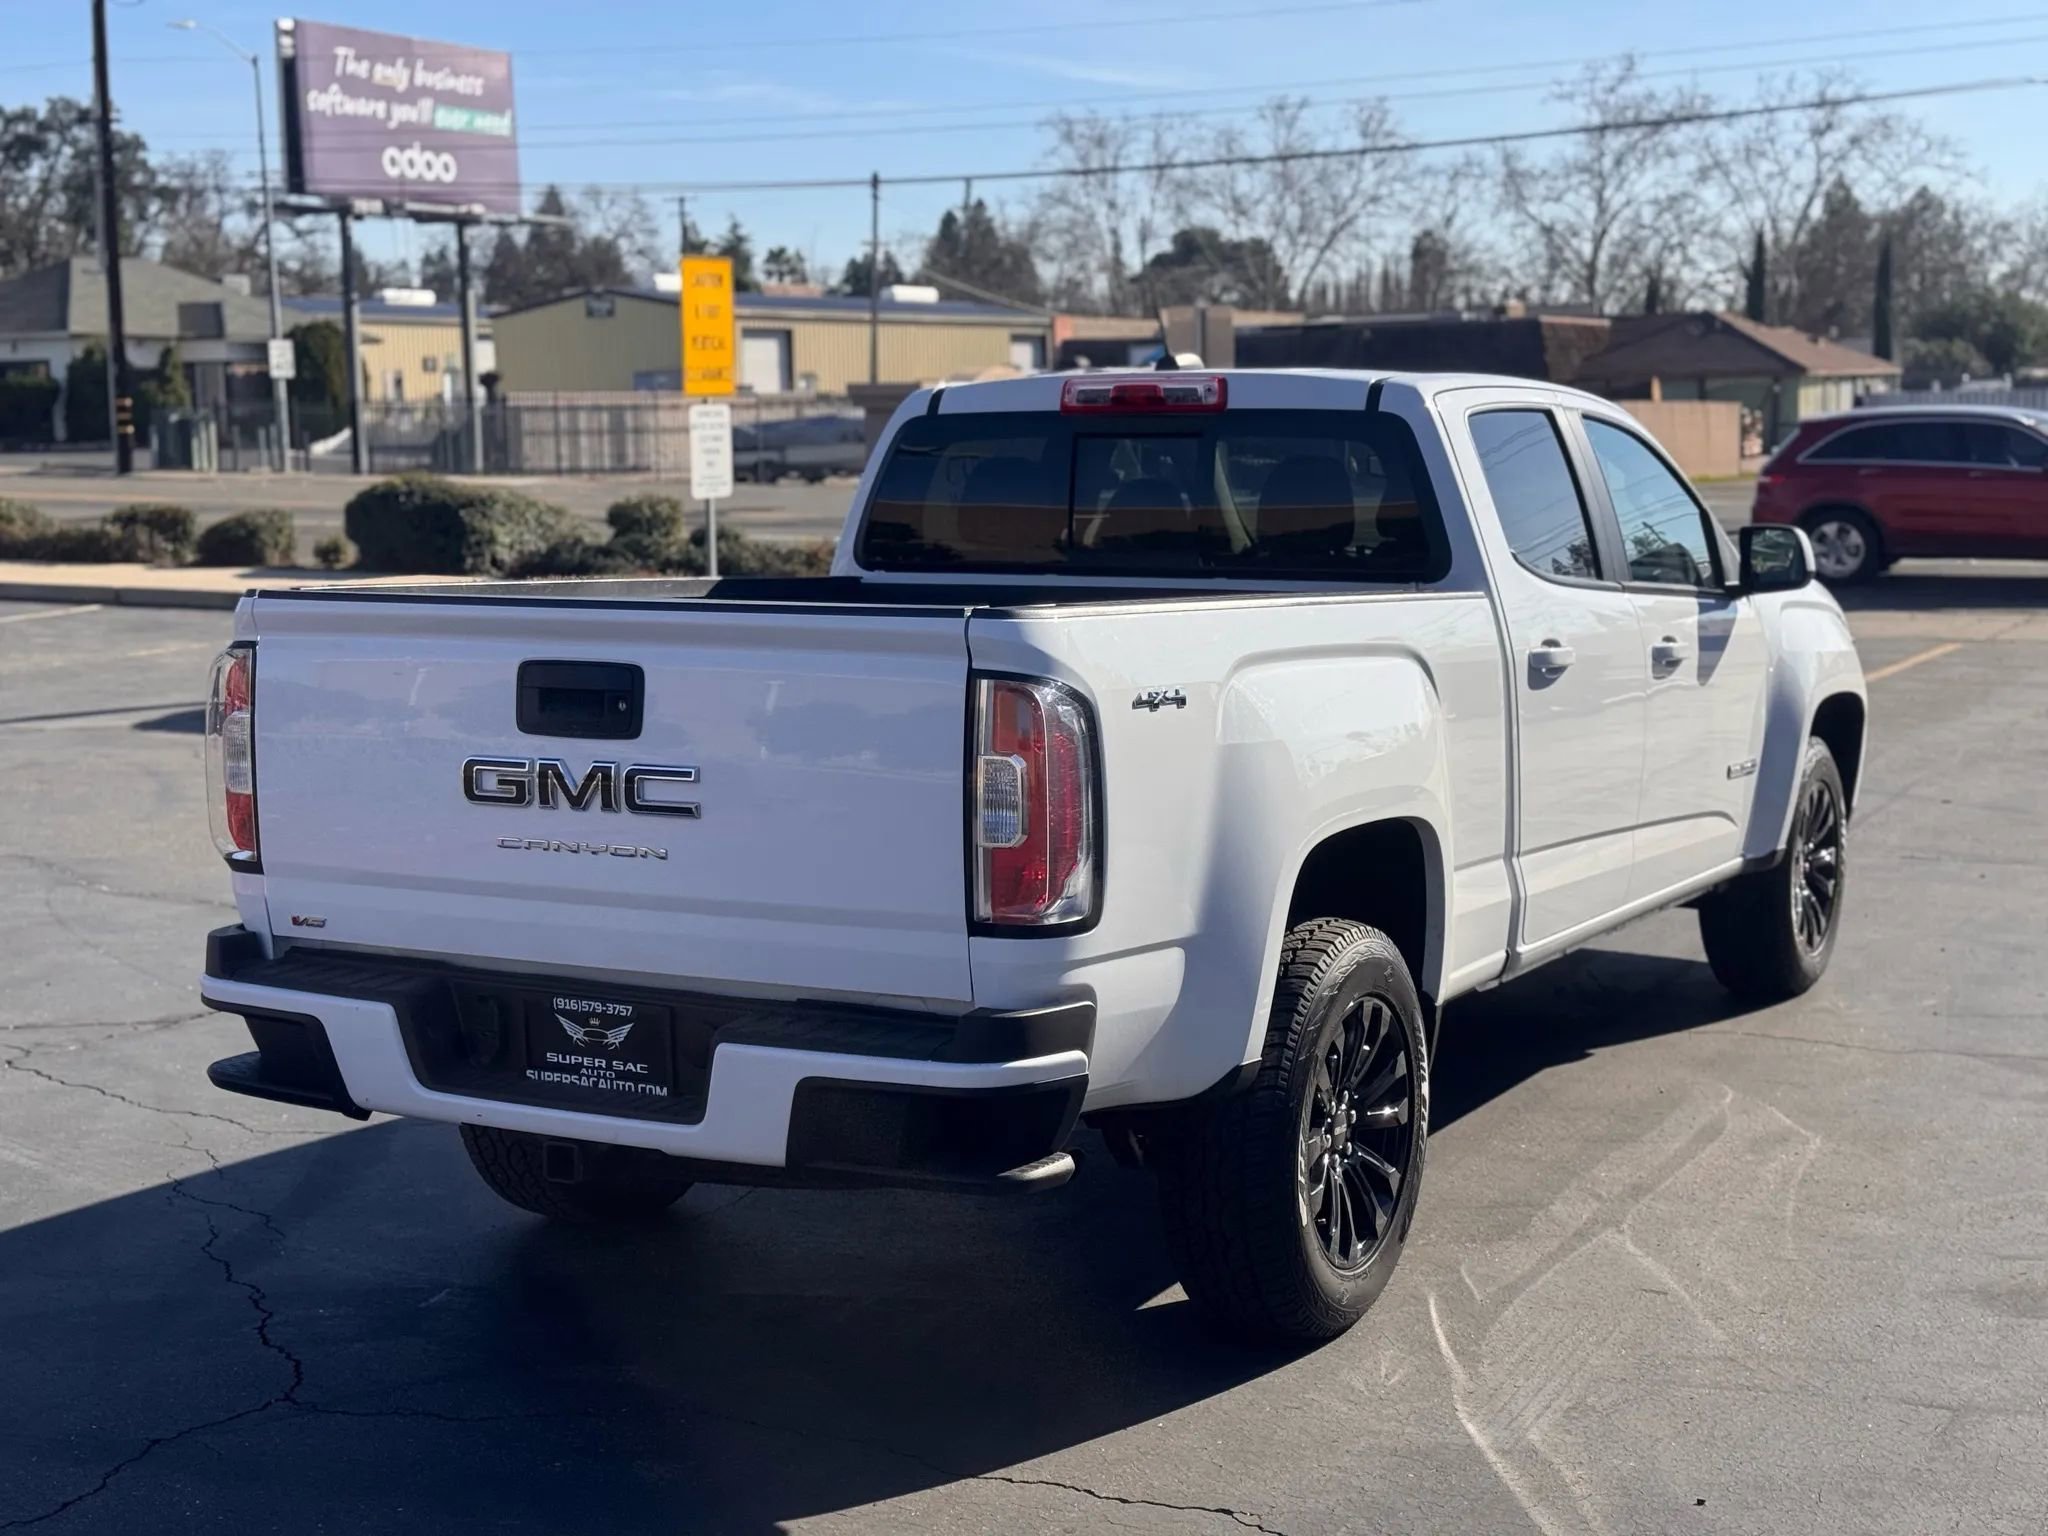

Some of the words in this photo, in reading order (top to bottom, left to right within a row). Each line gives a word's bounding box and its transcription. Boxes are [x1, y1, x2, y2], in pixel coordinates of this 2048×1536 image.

[334, 46, 370, 79] The
[372, 58, 410, 92] only
[413, 59, 485, 96] business
[306, 83, 387, 119] software
[381, 142, 457, 183] odoo
[462, 756, 701, 819] GMC
[497, 836, 668, 860] CANYON
[553, 997, 633, 1016] (916)579-3757
[546, 1052, 607, 1068] SUPER
[612, 1060, 649, 1074] SAC
[579, 1067, 616, 1079] AUTO
[526, 1069, 668, 1097] SUPERSACAUTOCOM
